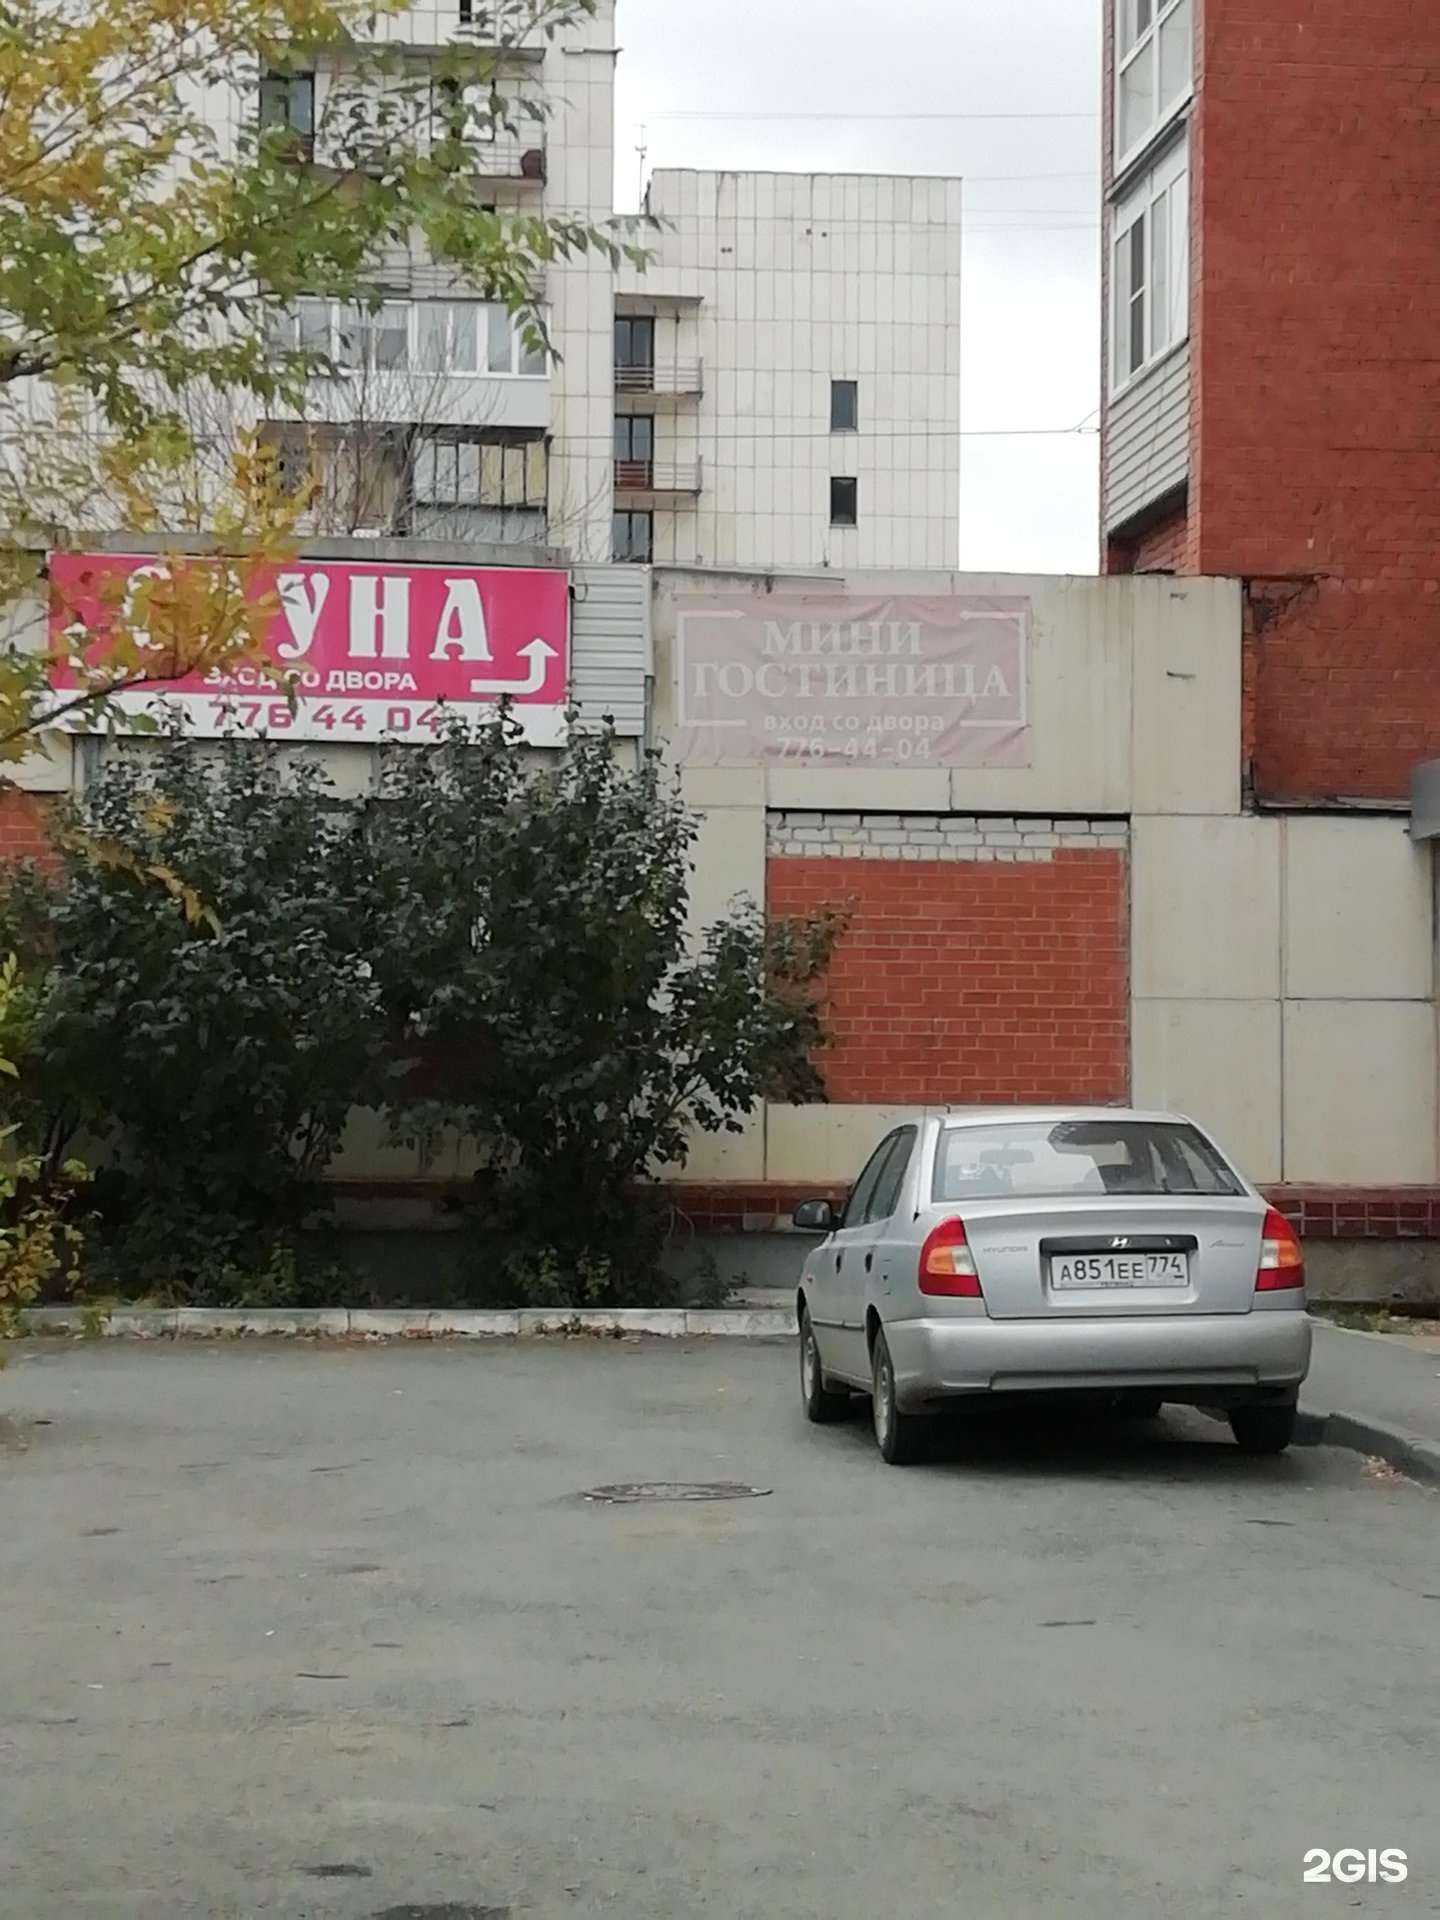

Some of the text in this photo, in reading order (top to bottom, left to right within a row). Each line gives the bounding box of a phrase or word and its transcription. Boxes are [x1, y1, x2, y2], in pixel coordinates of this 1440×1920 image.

[123, 565, 494, 662] СУНА
[762, 620, 924, 656] МИНИ
[325, 670, 418, 692] ДВОРА
[690, 661, 1012, 704] ГОСТИНИЦА
[208, 701, 292, 729] 776
[312, 704, 367, 731] 44
[763, 715, 945, 735] вход со двора
[776, 737, 931, 760] 776-44-04
